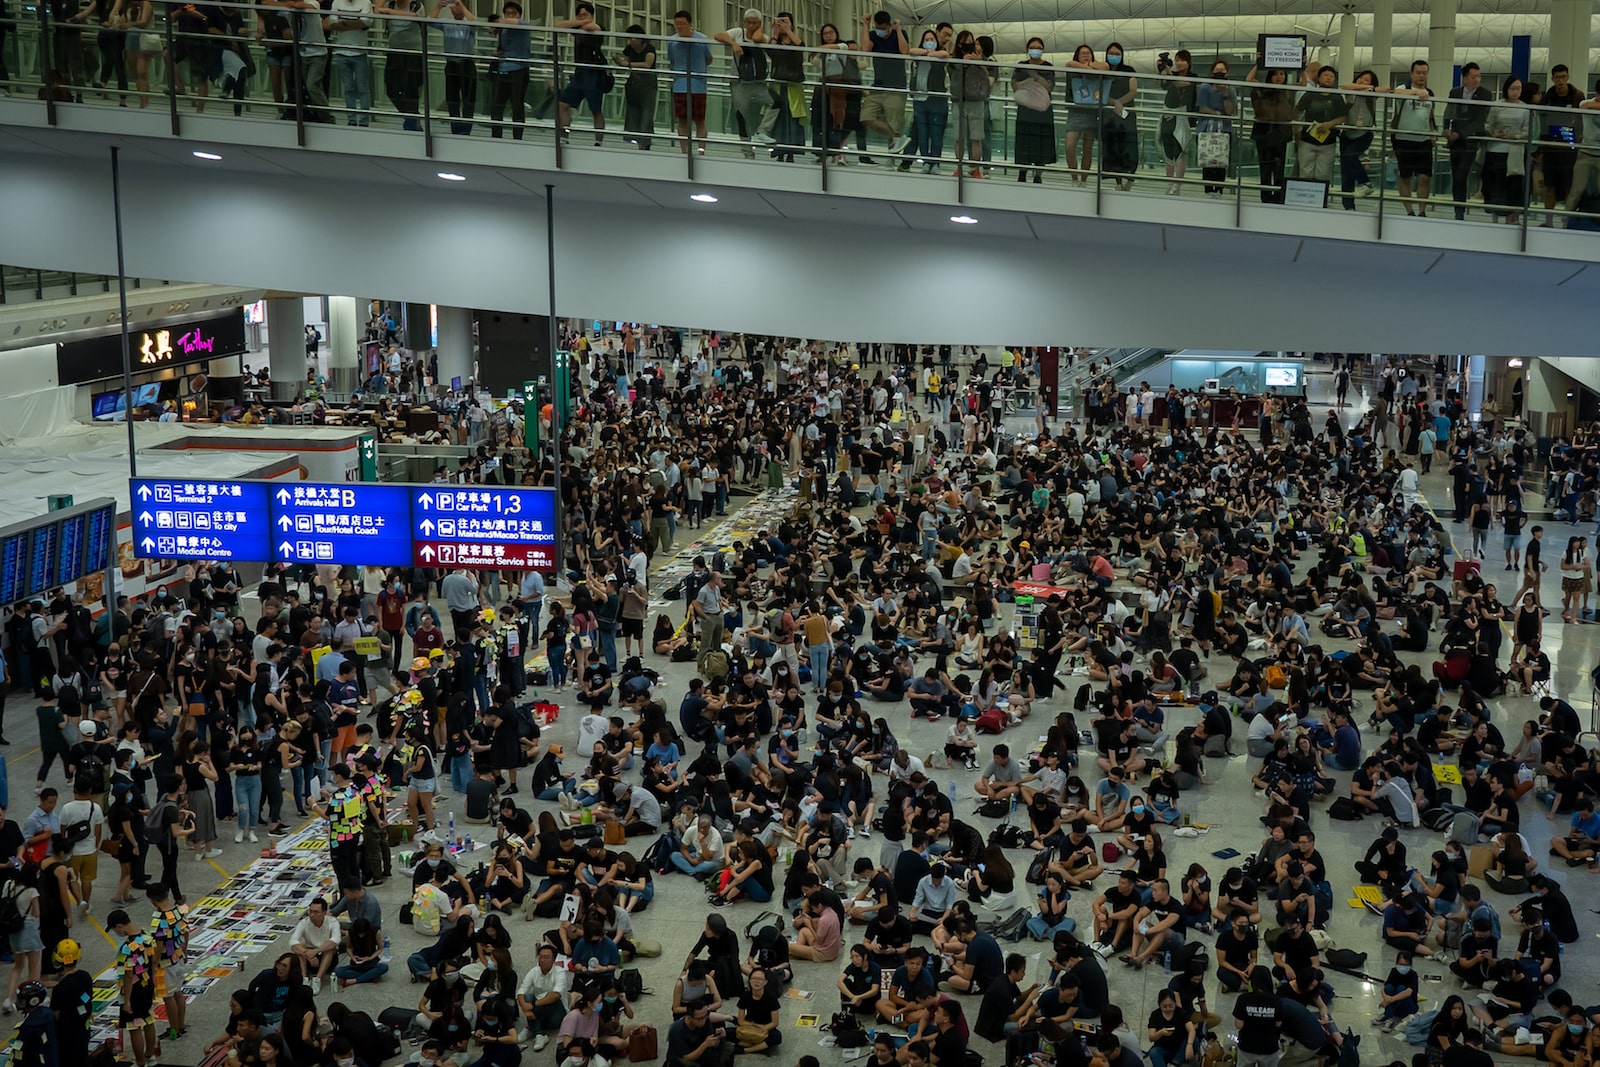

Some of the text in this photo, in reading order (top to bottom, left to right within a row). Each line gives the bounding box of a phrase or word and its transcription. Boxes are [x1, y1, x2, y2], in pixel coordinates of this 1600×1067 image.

[157, 489, 170, 498] T2
[173, 484, 241, 496] 二號客運大樓
[294, 487, 340, 499] 接機大堂
[173, 494, 205, 503] Terminal
[295, 498, 339, 507] Arrivals Hall
[342, 490, 355, 507] B
[441, 495, 450, 509] P
[456, 492, 491, 503] 停車場
[456, 503, 470, 511] Car
[493, 495, 521, 515] 1,3
[213, 511, 246, 523] 往市區
[213, 522, 237, 531] To city
[315, 525, 378, 534] Tour/Hotel Coach
[458, 530, 554, 541] Mainland/Macao Transport
[177, 537, 222, 547] 醫療中心
[177, 547, 231, 556] Medical Centre
[458, 544, 505, 556] 旅客服務
[458, 556, 524, 565] Customer Service
